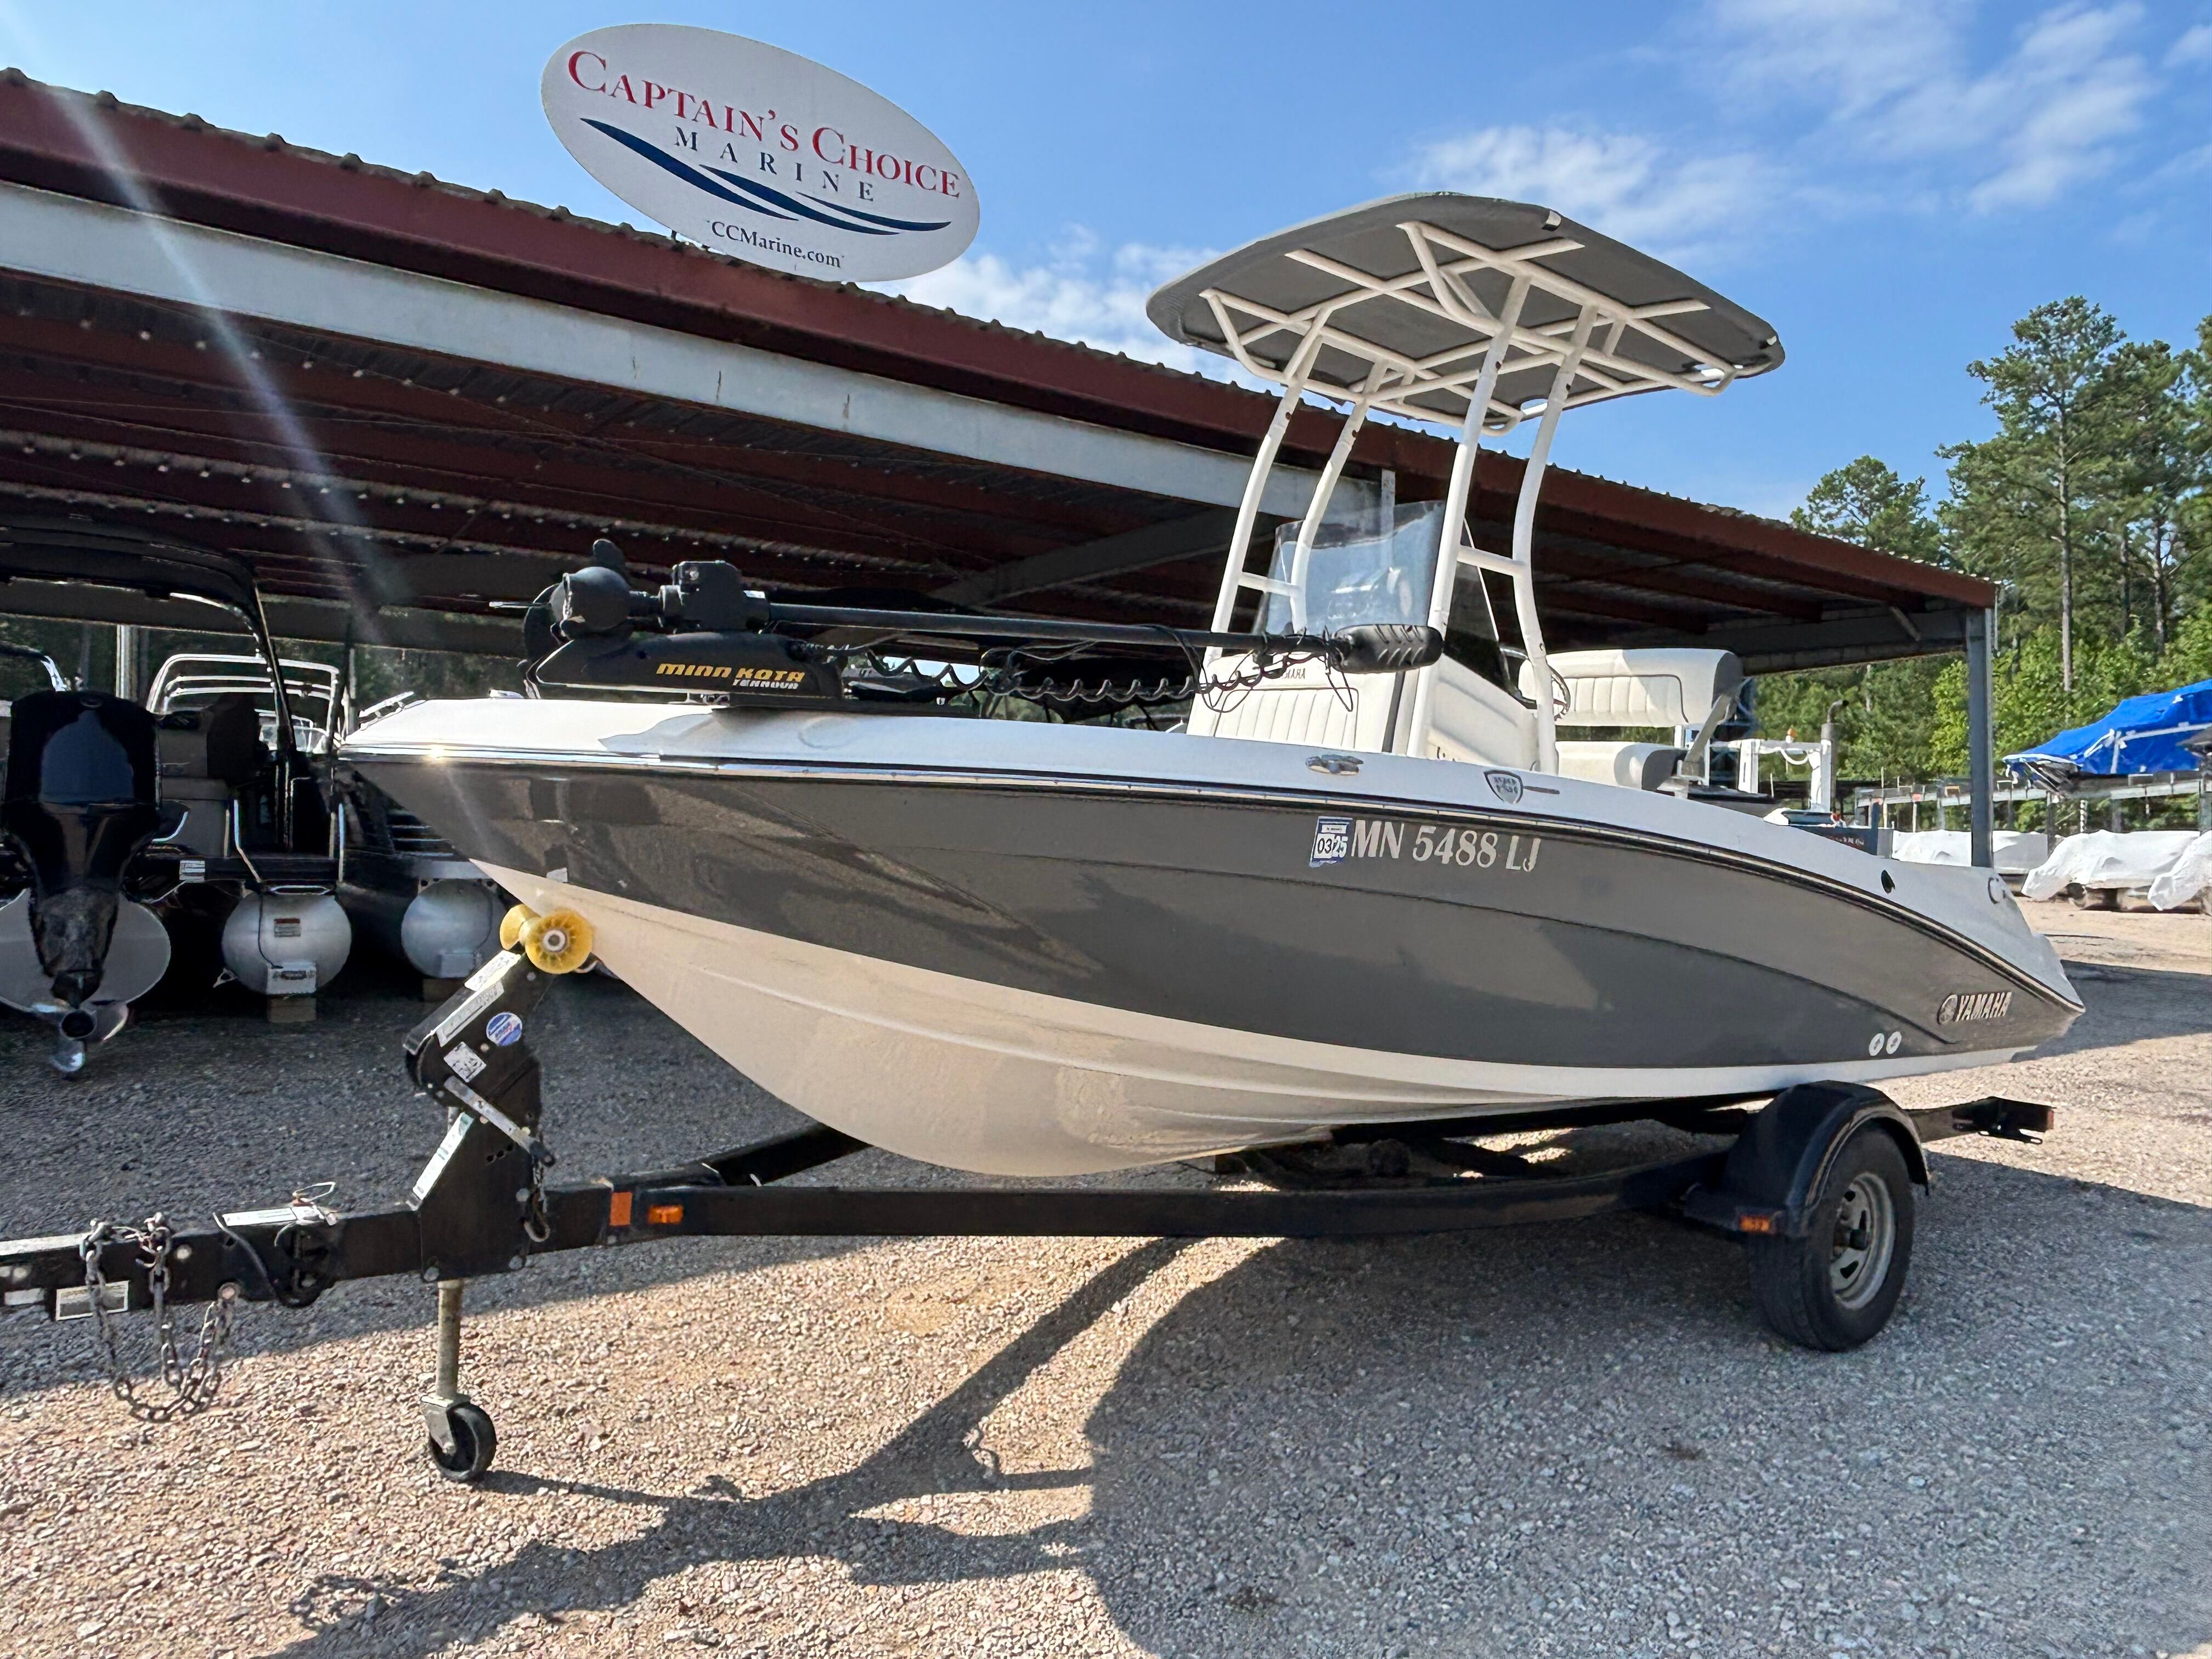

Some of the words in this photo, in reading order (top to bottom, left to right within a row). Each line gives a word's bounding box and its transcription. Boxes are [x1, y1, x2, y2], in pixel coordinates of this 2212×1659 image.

[567, 50, 800, 151] CAPTAIN'S
[812, 126, 961, 199] CHOICE
[674, 126, 874, 202] MARINE
[710, 220, 842, 268] CCMarine.com
[656, 663, 732, 679] MINN
[735, 667, 806, 683] KOTA
[1351, 819, 1404, 859] MN
[1412, 825, 1498, 868] 5488
[1505, 835, 1541, 872] LJ
[1955, 991, 2012, 1023] YAMAHA
